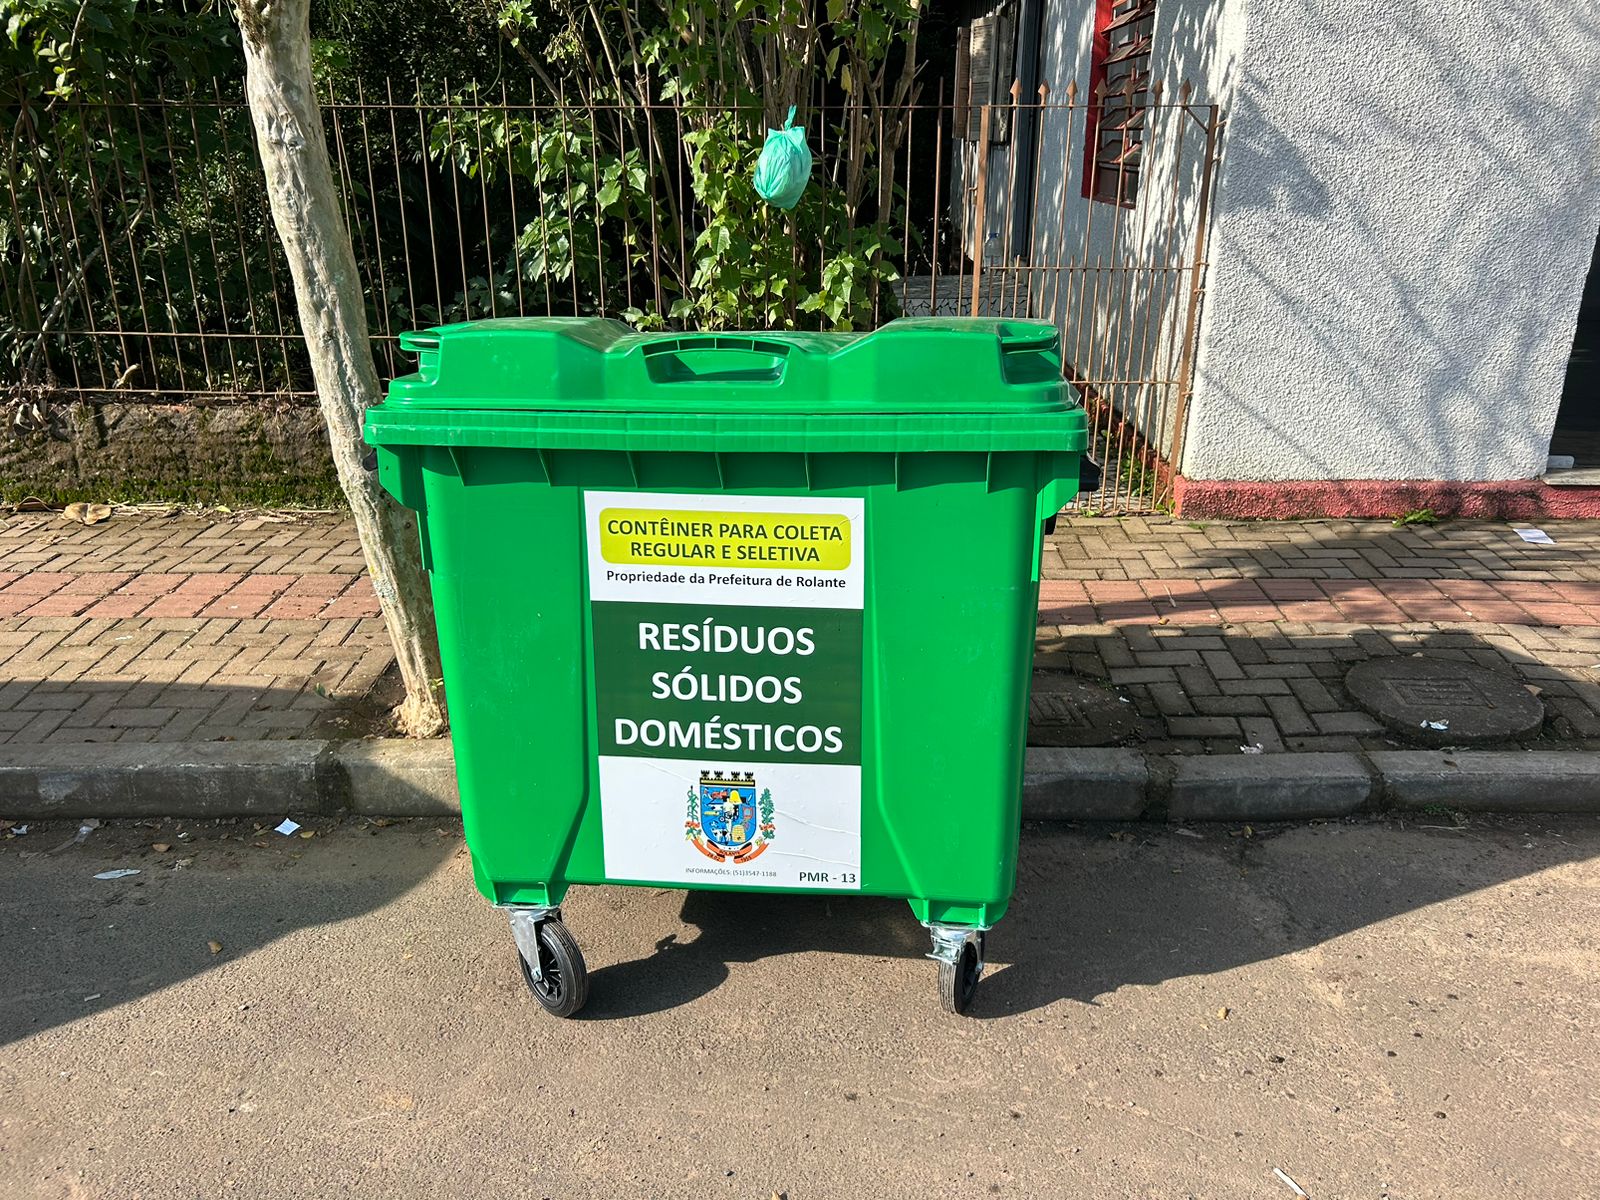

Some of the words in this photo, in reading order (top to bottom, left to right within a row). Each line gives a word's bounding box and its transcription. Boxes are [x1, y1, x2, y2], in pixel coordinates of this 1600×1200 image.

[608, 517, 714, 538] CONTÊINER
[719, 523, 768, 539] PARA
[773, 525, 843, 541] COLETA
[630, 541, 716, 559] REGULAR
[721, 545, 732, 560] E
[737, 545, 820, 562] SELETIVA
[606, 570, 686, 585] Propriedade
[689, 572, 705, 584] da
[708, 573, 772, 587] Prefeitura
[776, 575, 792, 587] de
[796, 576, 846, 588] Rolante
[638, 617, 815, 656] RESÍDUOS
[652, 665, 803, 705] SÓLIDOS
[614, 715, 843, 754] DOMÉSTICOS
[799, 871, 829, 883] PMR
[841, 873, 856, 884] 13
